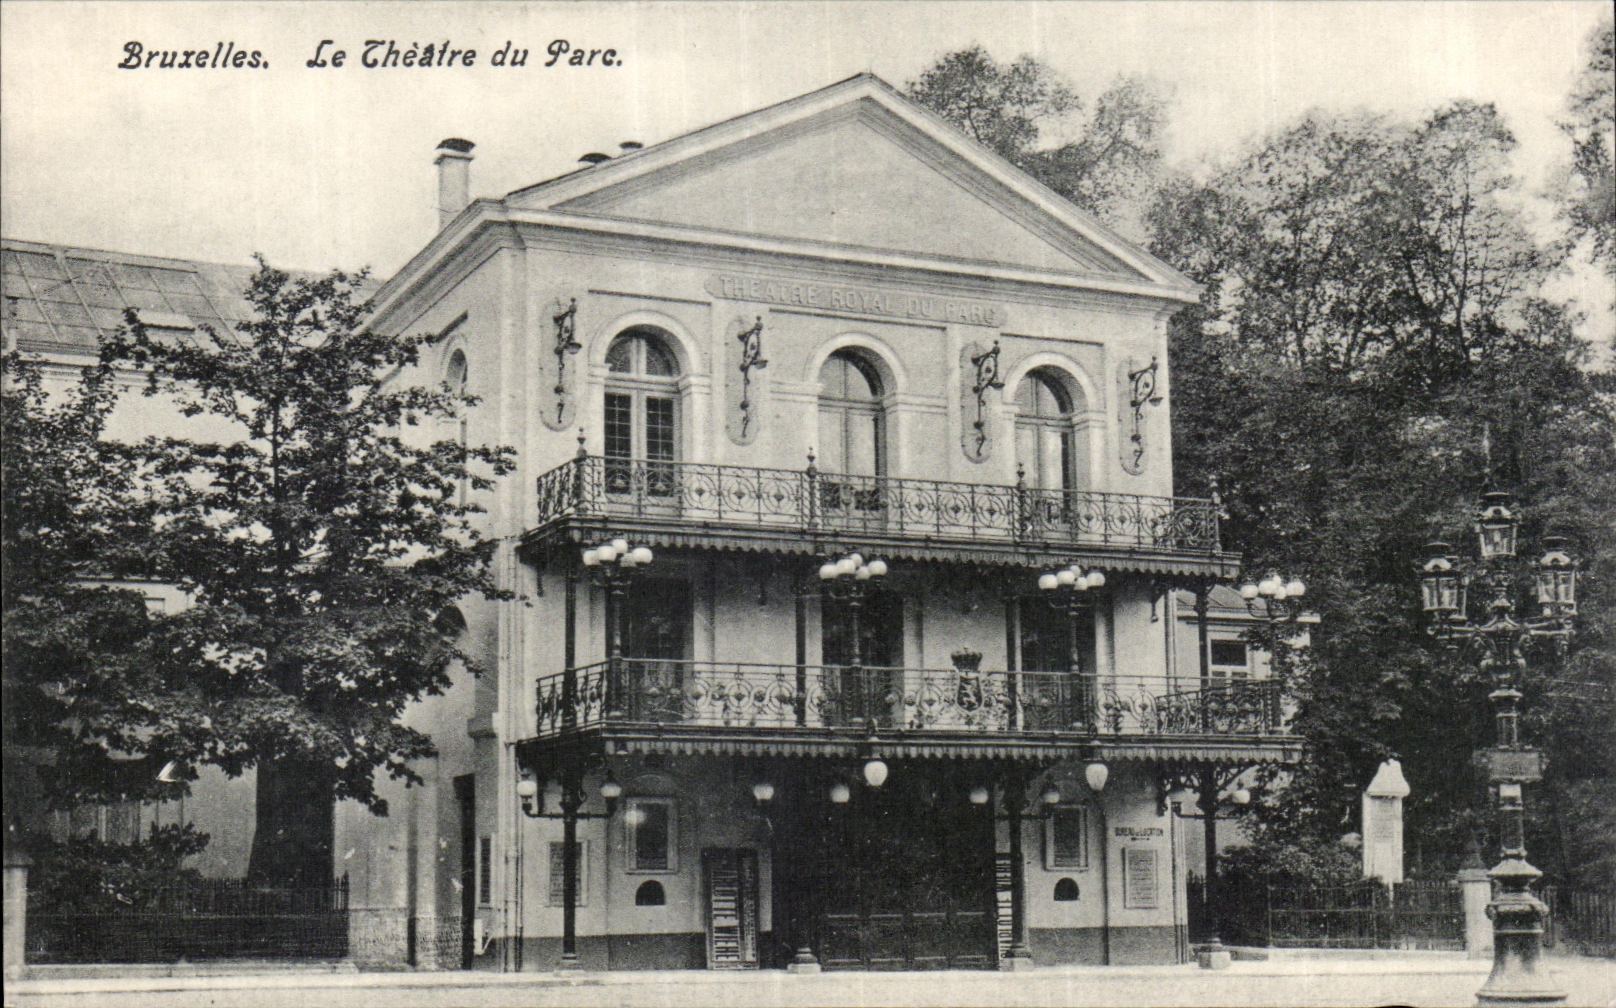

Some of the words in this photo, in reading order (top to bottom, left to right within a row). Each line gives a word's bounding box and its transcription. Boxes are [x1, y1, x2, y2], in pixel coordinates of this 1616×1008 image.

[830, 286, 893, 315] ROYAL
[906, 295, 935, 318] DU
[945, 301, 997, 325] PARC
